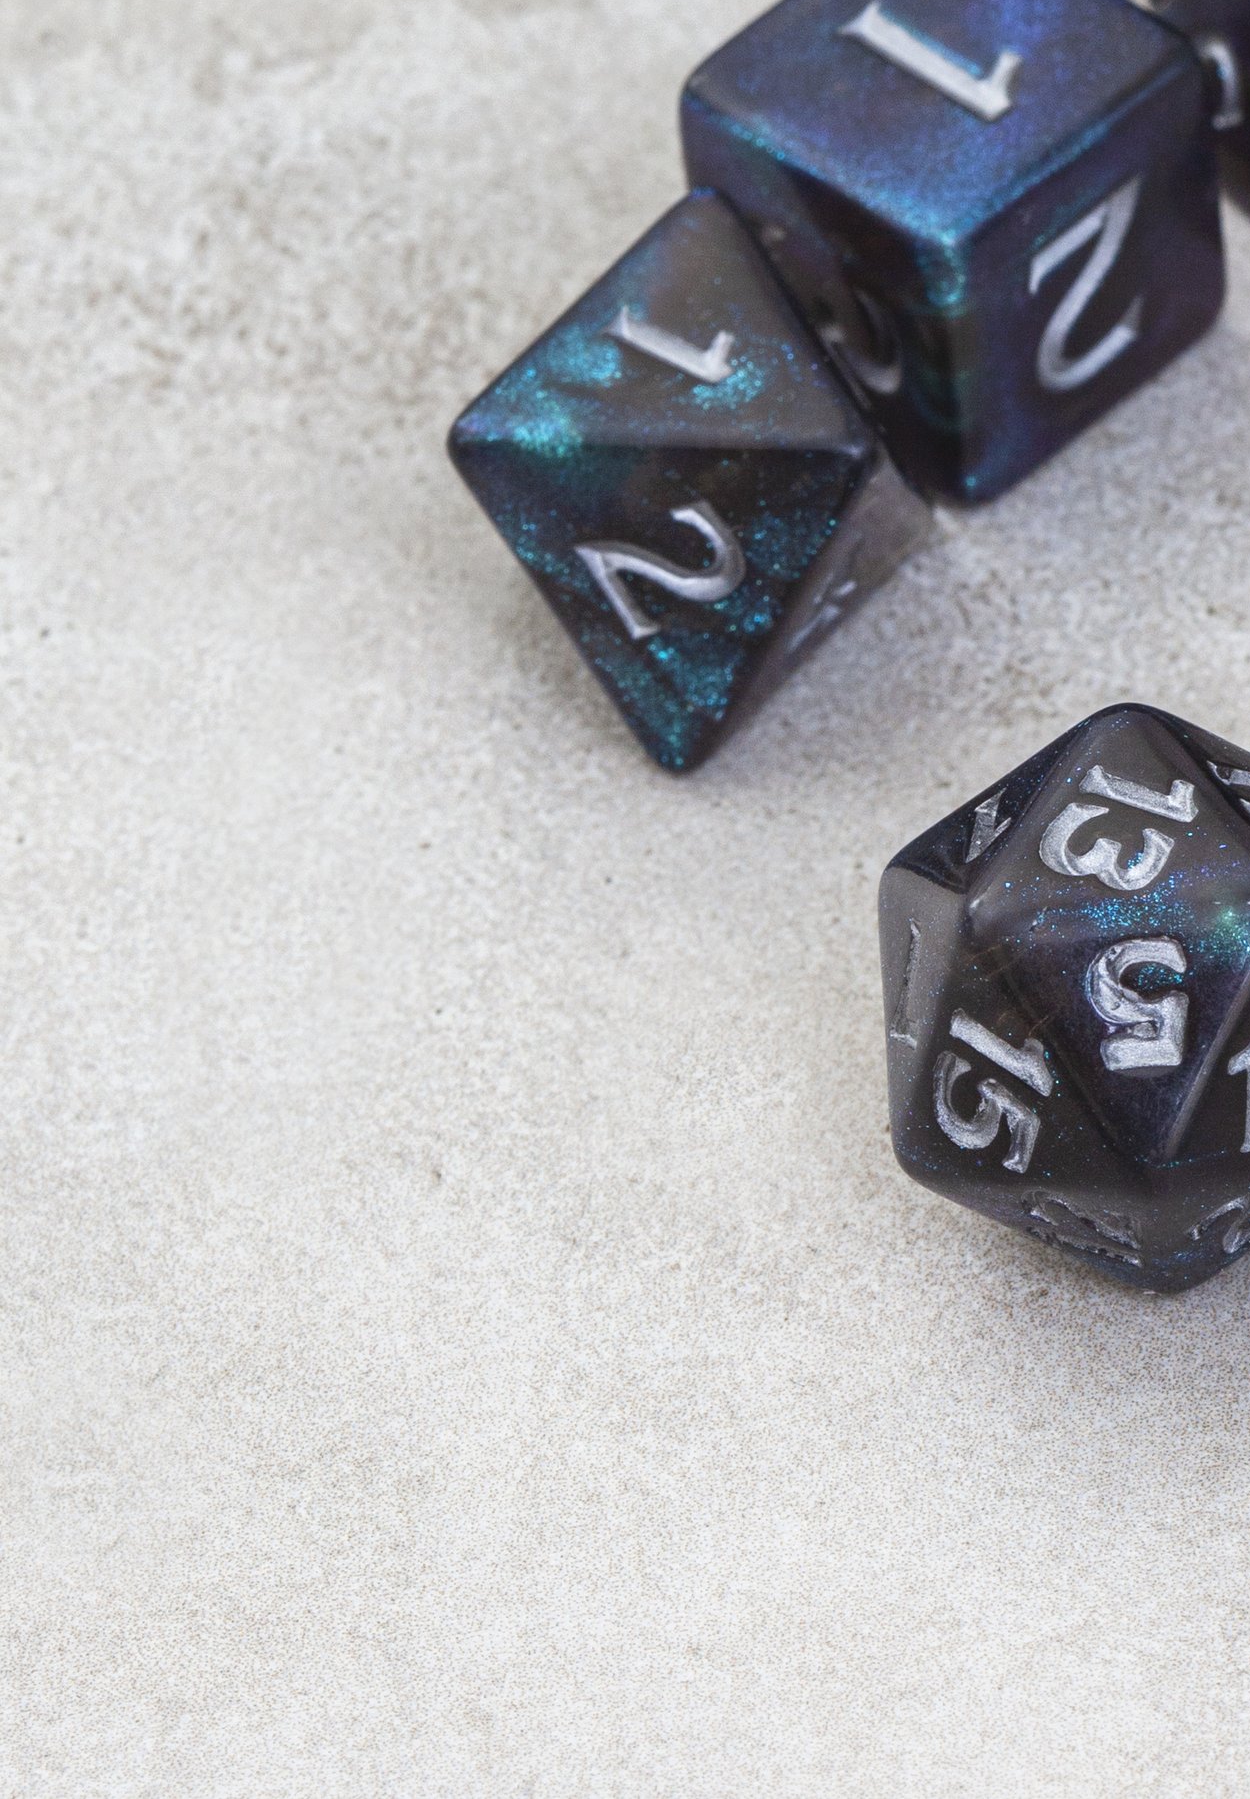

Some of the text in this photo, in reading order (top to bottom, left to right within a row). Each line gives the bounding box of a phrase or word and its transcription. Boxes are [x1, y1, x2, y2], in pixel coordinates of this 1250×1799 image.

[837, 0, 1022, 122] 1
[607, 304, 736, 384] 1
[1029, 174, 1145, 392] 2
[572, 502, 748, 640] 2
[1039, 764, 1199, 891] 13
[1089, 935, 1190, 1073] 5
[933, 1007, 1055, 1174] 15
